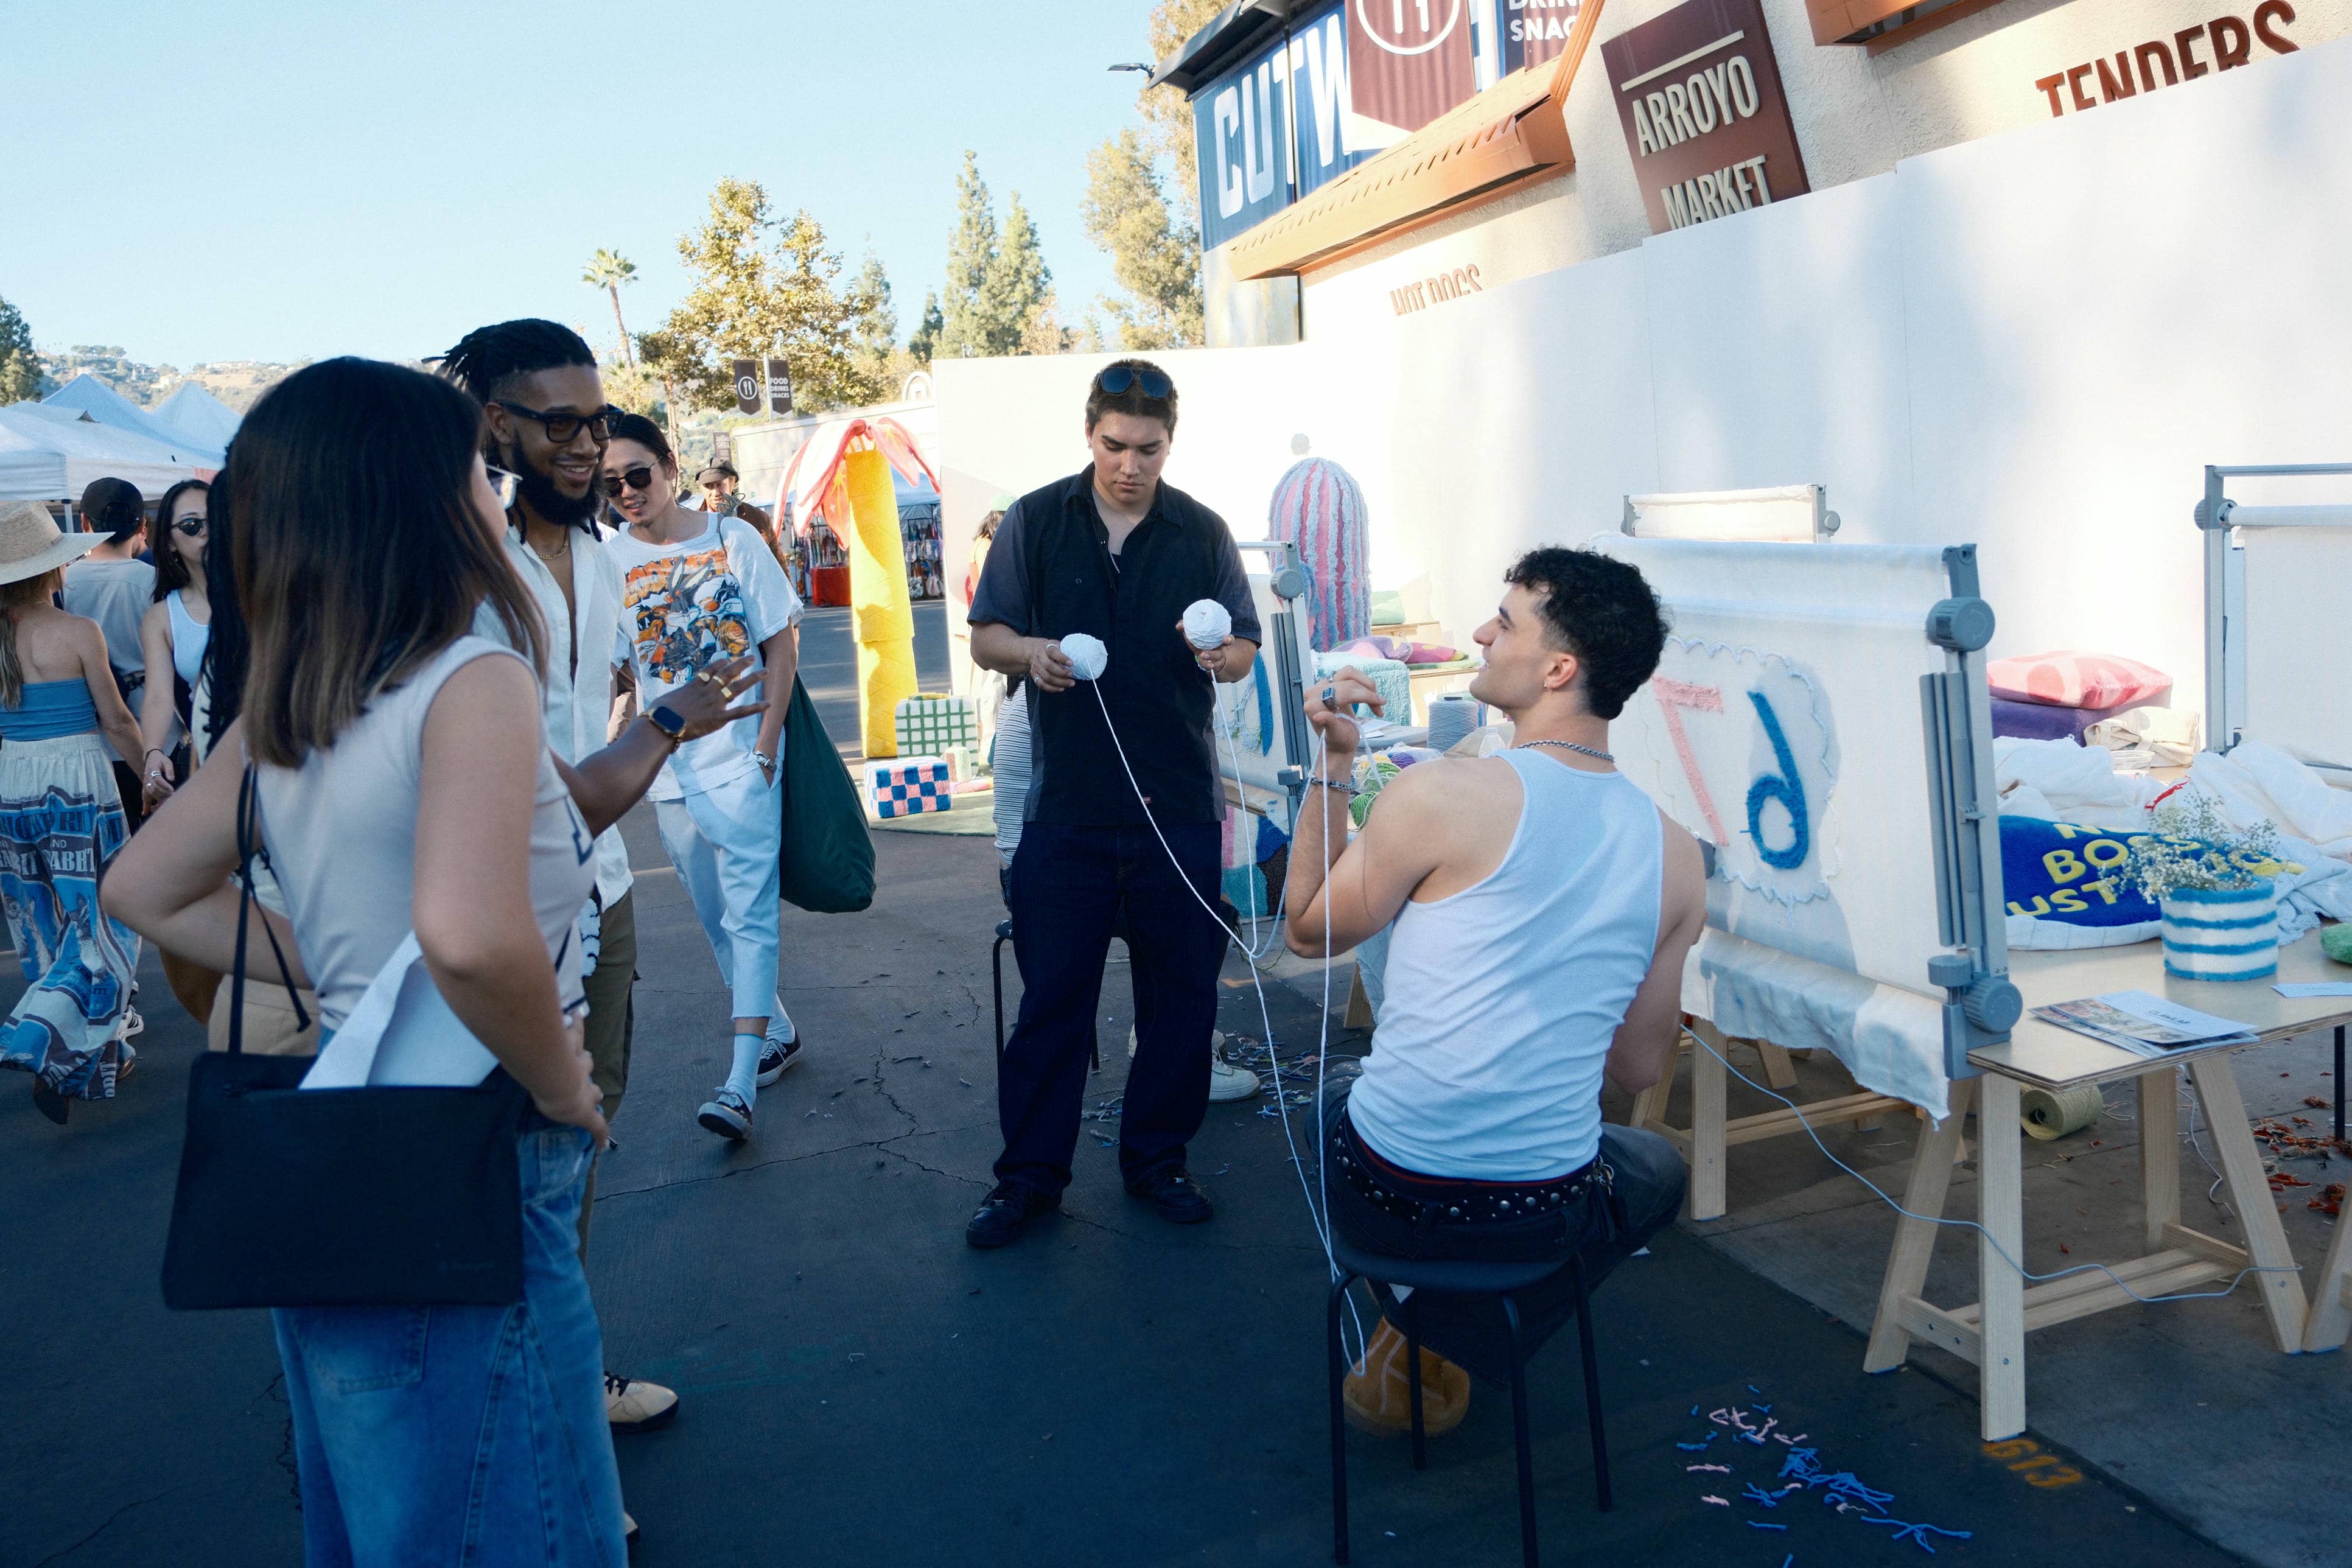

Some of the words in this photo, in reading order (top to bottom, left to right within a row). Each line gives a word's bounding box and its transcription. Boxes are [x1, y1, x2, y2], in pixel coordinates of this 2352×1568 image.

[1632, 55, 1759, 157] ARROYO
[2035, 0, 2300, 117] TENDERS
[1661, 154, 1772, 230] MARKET
